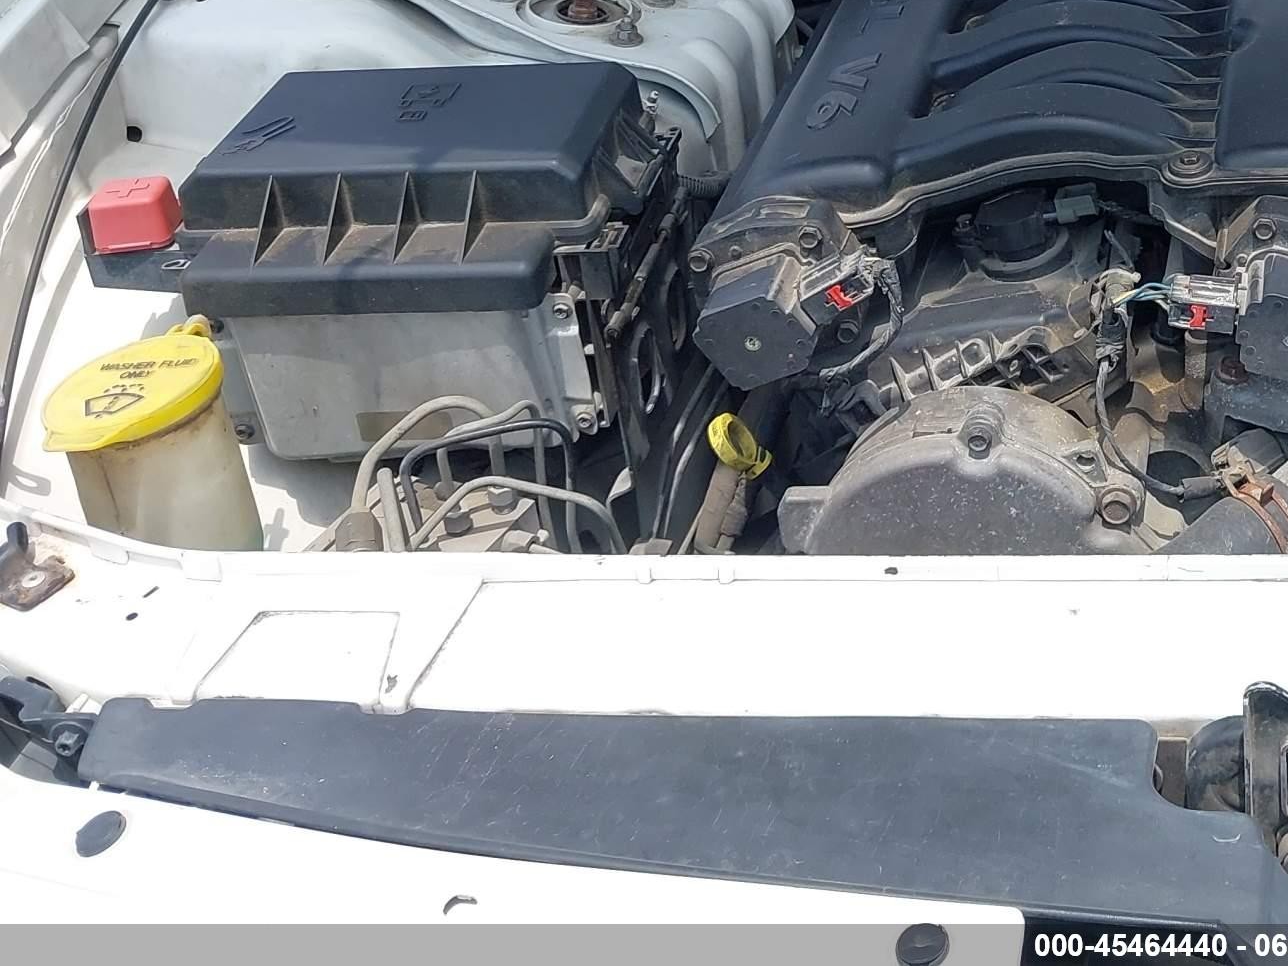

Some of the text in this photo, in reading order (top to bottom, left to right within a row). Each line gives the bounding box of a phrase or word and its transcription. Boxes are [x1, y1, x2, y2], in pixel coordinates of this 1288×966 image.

[806, 52, 883, 130] V6
[99, 358, 197, 372] WASHER FLUID
[119, 369, 155, 380] ONLY
